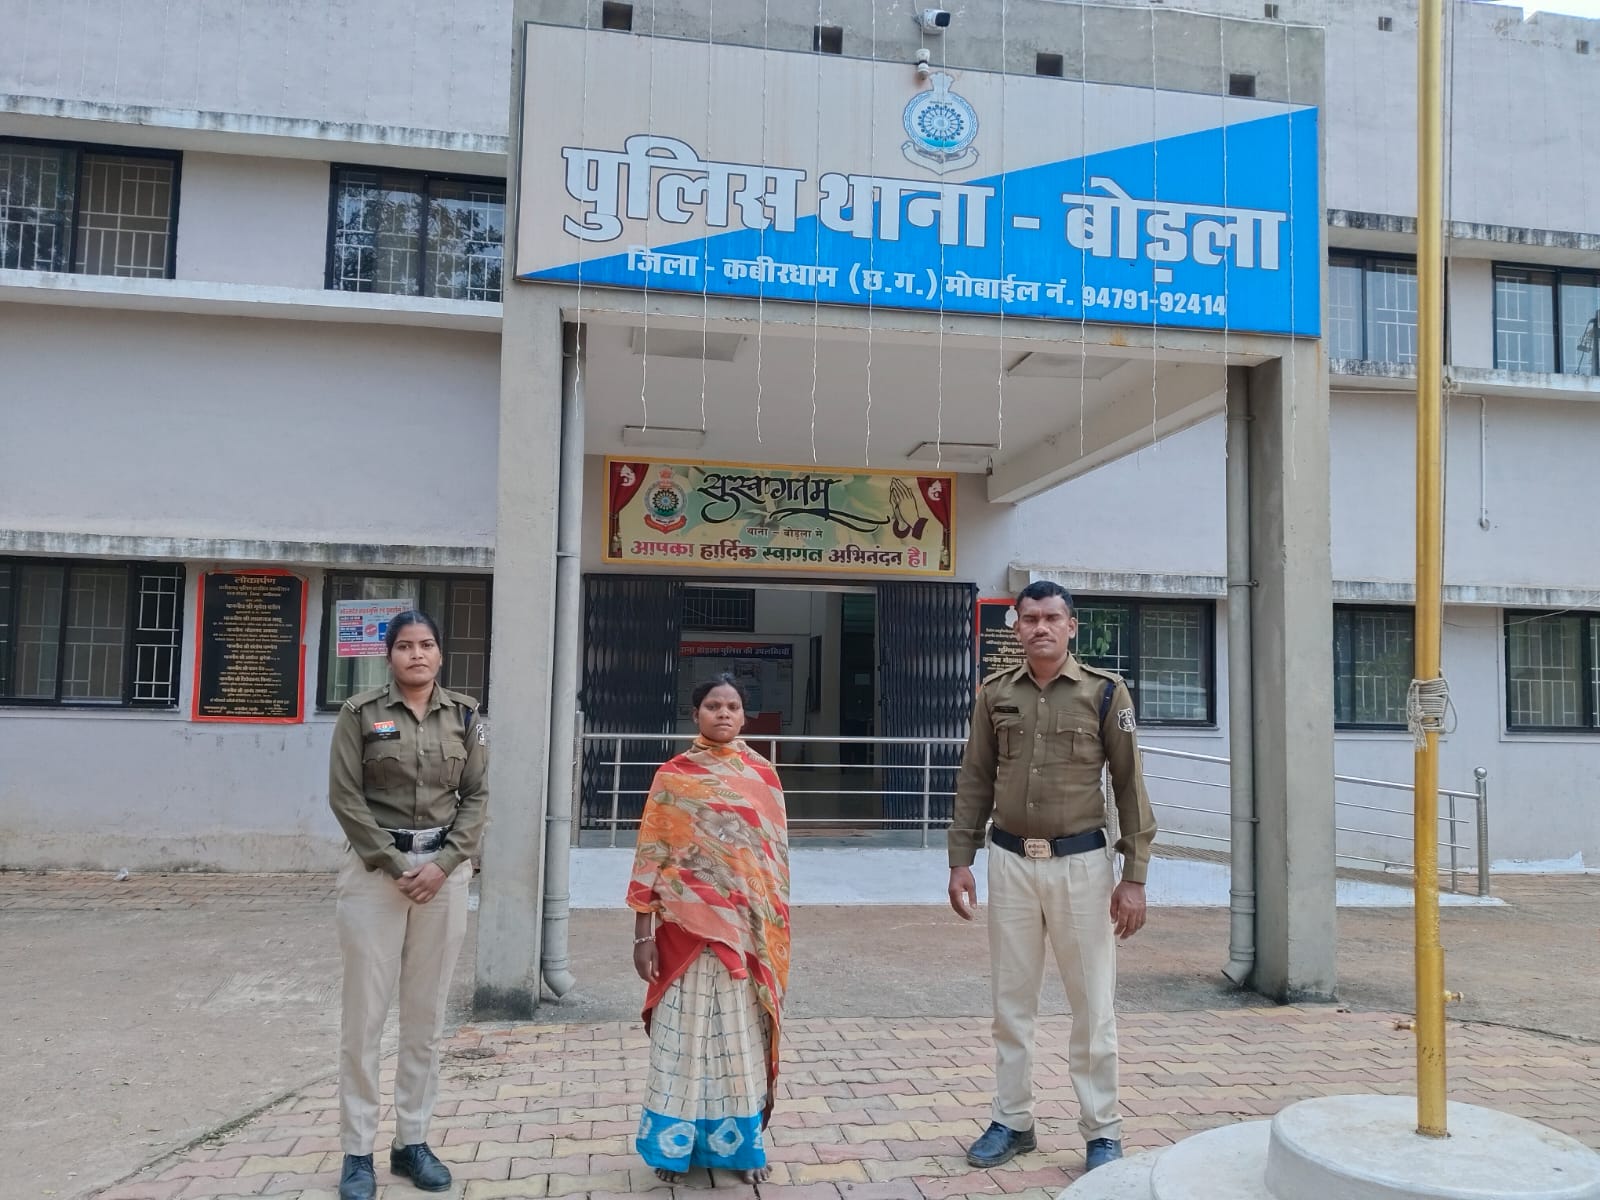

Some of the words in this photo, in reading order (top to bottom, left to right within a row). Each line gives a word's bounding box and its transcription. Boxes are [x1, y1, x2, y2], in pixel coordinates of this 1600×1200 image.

[561, 134, 806, 242] पुलिस
[819, 172, 995, 248] थाना
[1062, 176, 1288, 284] बोड़ला
[627, 245, 698, 277] जिला
[722, 255, 838, 288] कबीरधाम
[849, 262, 937, 300] (छ.ग.)
[945, 271, 1041, 304] मोबाईल
[1046, 278, 1073, 306] नं.
[1082, 286, 1226, 317] 94791-92414
[631, 541, 695, 558] आपका
[700, 539, 757, 560] हार्दिक
[763, 546, 823, 562] स्वागत
[829, 544, 903, 566] अभिनंदन
